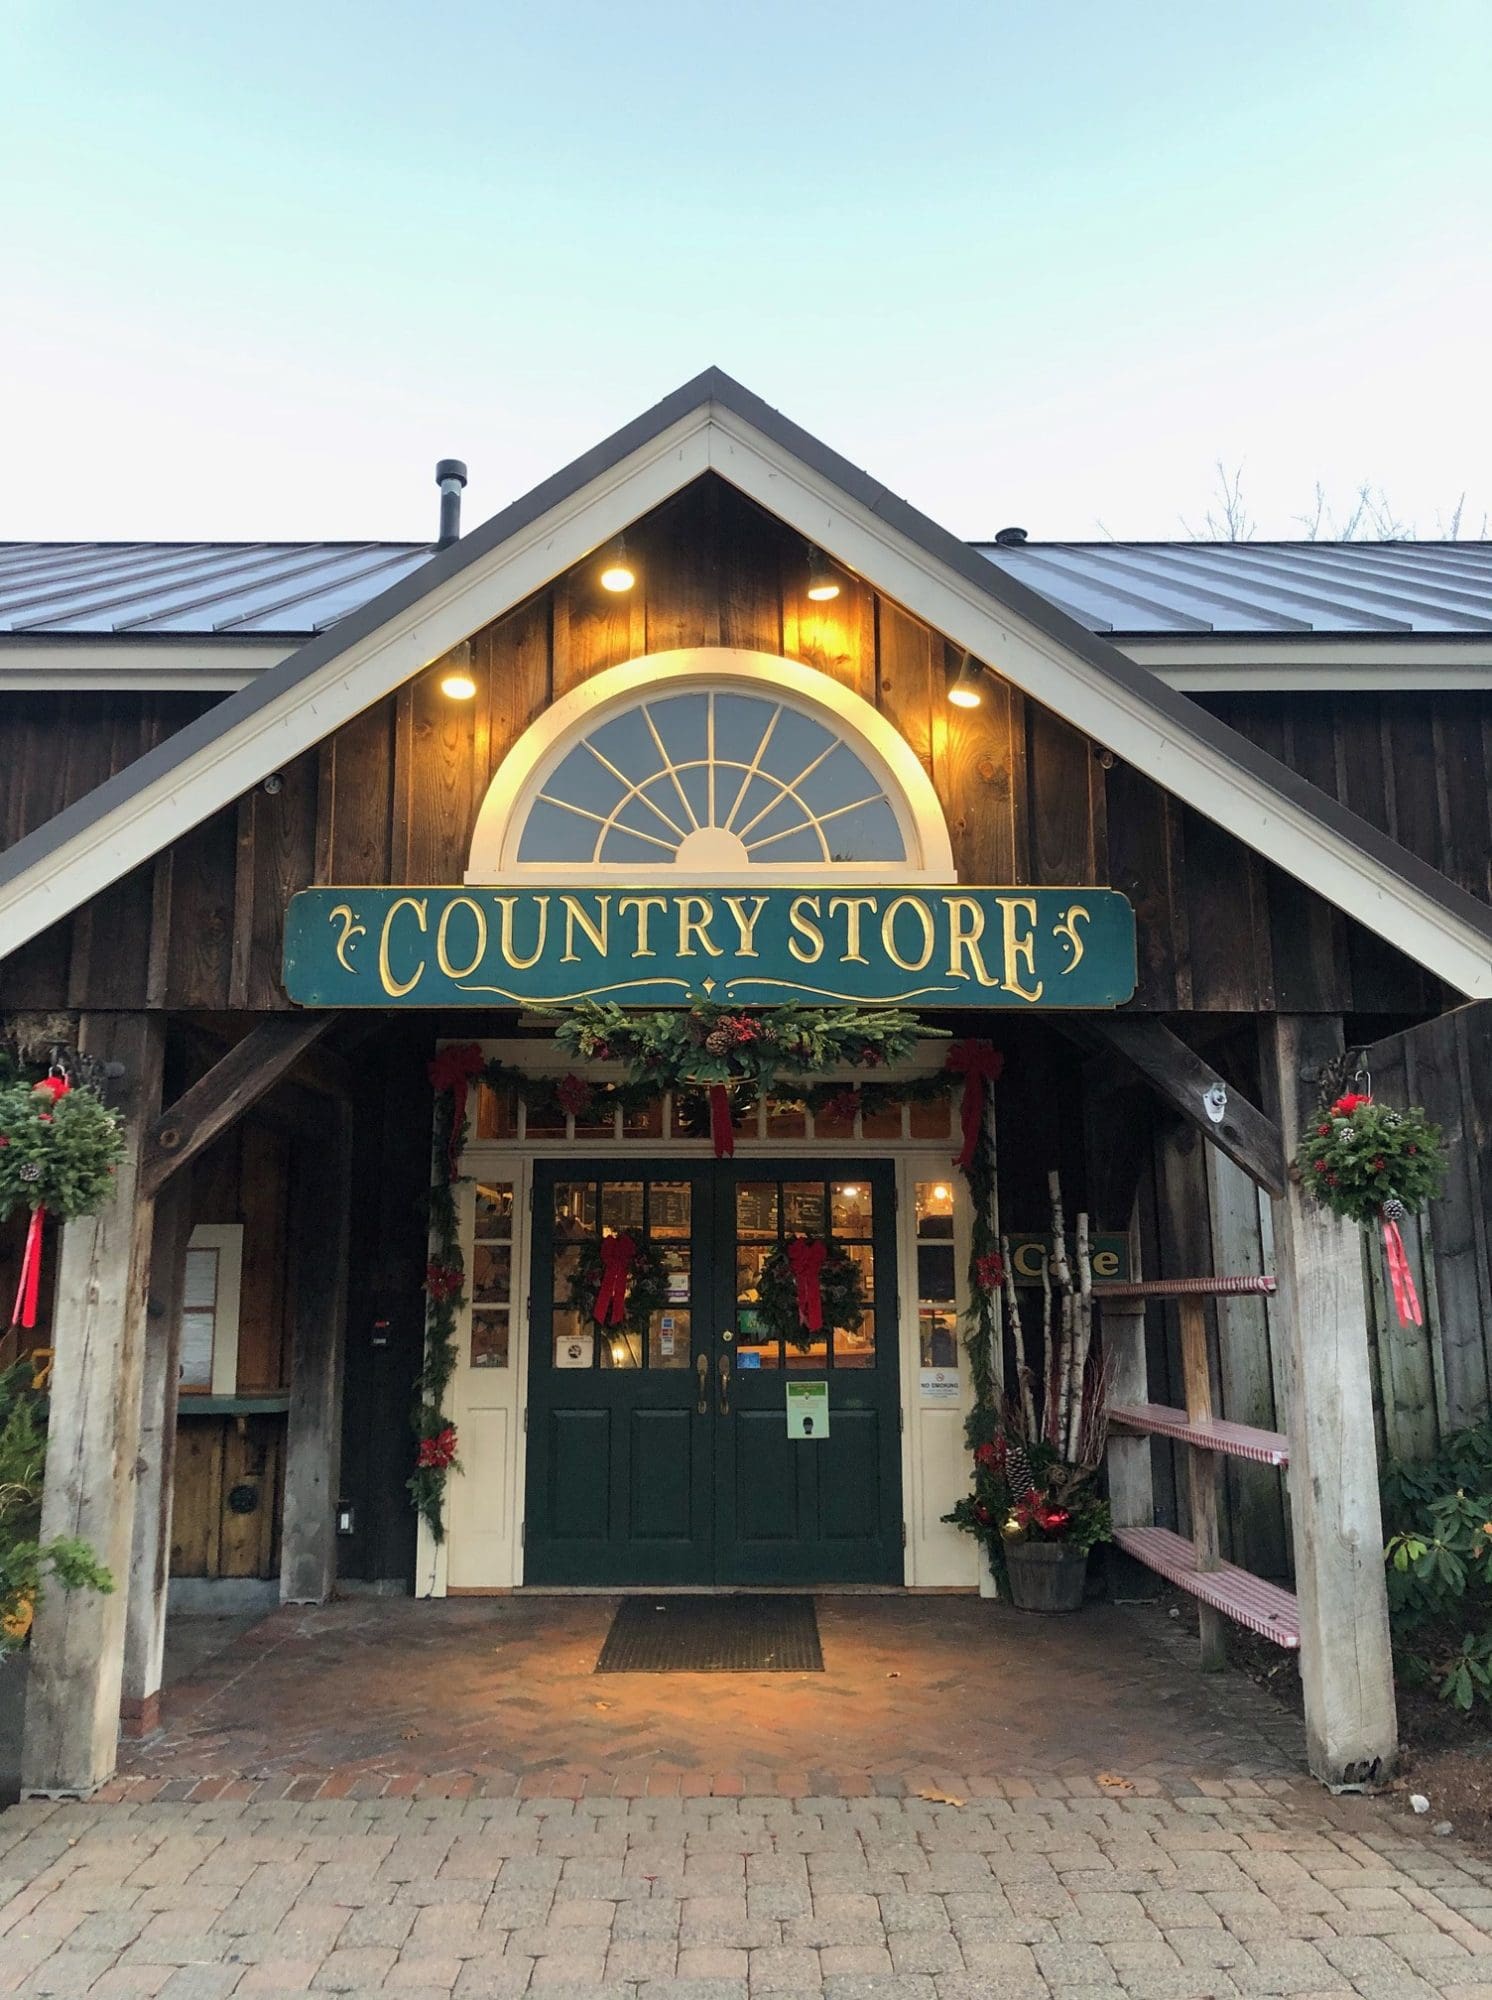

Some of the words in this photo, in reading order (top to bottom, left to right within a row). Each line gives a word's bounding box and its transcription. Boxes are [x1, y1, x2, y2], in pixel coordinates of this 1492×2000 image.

[379, 895, 770, 998] COUNTRY
[788, 895, 1043, 1002] STORE
[1013, 1243, 1119, 1276] Cae
